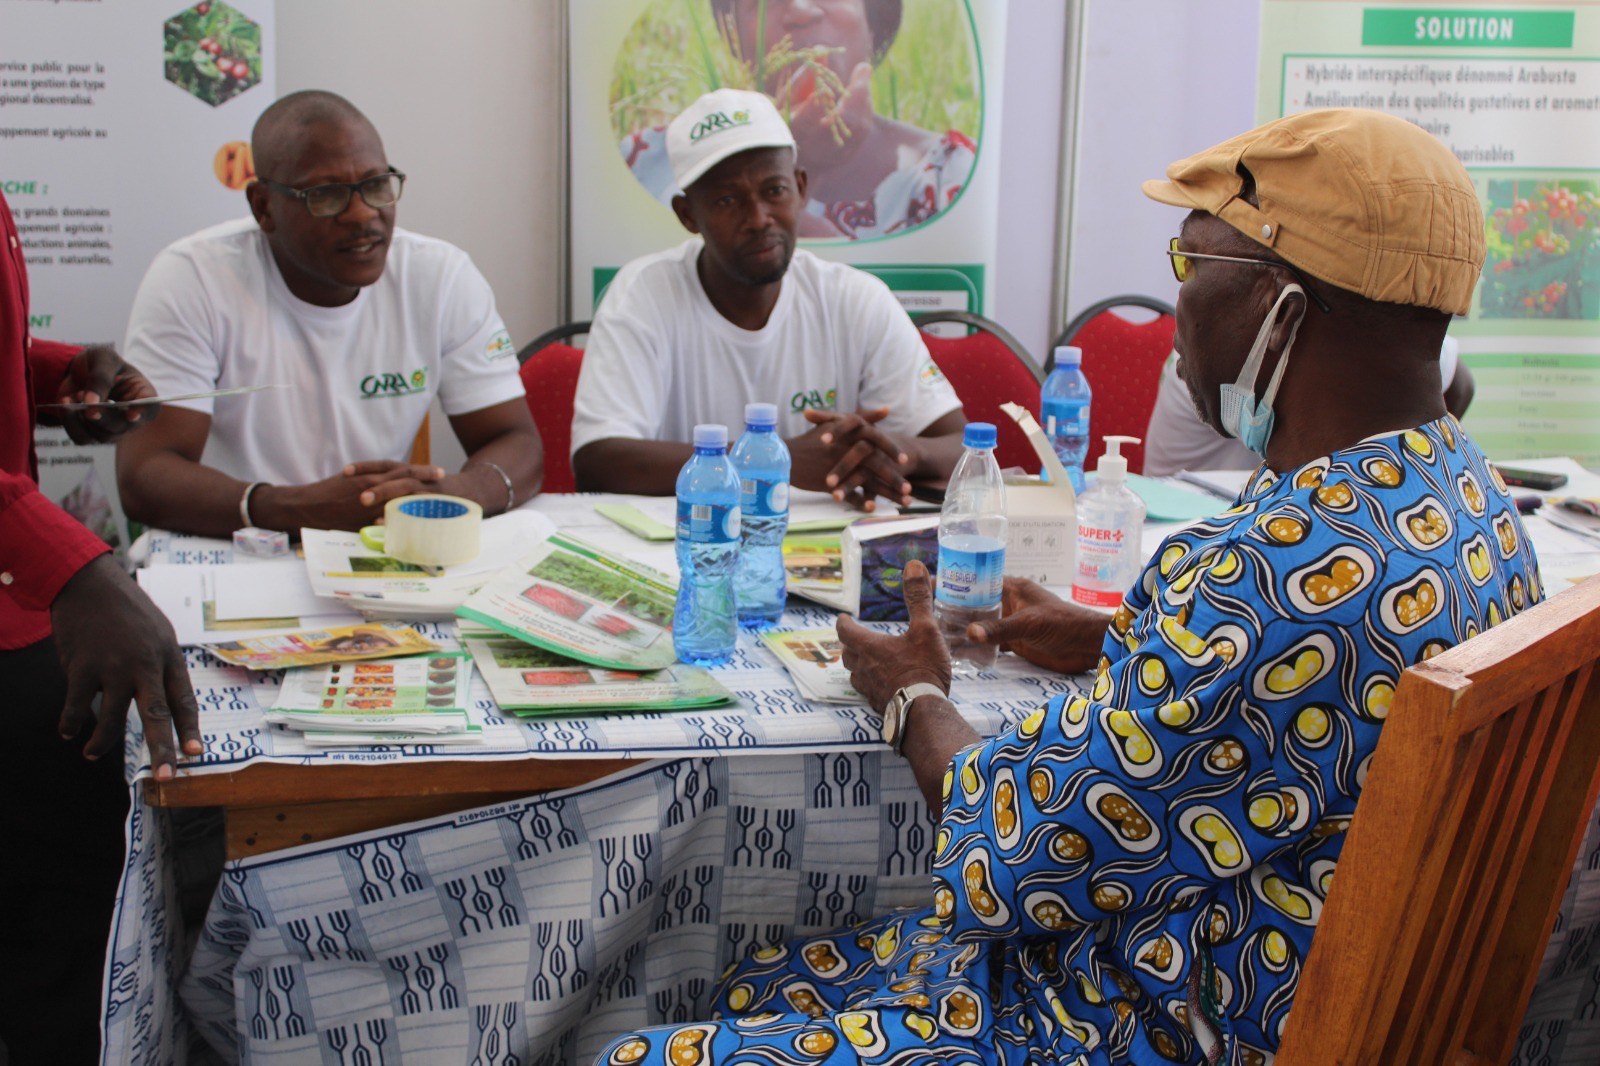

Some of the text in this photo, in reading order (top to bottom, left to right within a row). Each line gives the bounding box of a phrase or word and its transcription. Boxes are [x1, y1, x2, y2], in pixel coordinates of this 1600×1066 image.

[1414, 16, 1514, 40] SOLUTION
[31, 61, 62, 74] public
[67, 64, 91, 74] pour
[1305, 64, 1577, 87] Hybride interspécifique dénommé Arabusta
[31, 79, 66, 90] gestion
[69, 79, 81, 88] de
[84, 80, 105, 92] type
[1303, 91, 1385, 107] Amélioration
[1388, 91, 1410, 108] des
[1414, 91, 1465, 112] qualités
[1469, 92, 1531, 114] gustatives
[1535, 95, 1548, 109] et
[52, 126, 92, 140] agricole
[24, 207, 58, 219] grands
[62, 207, 110, 217] domaines
[360, 373, 409, 395] CNRA
[1078, 525, 1112, 541] SUPER
